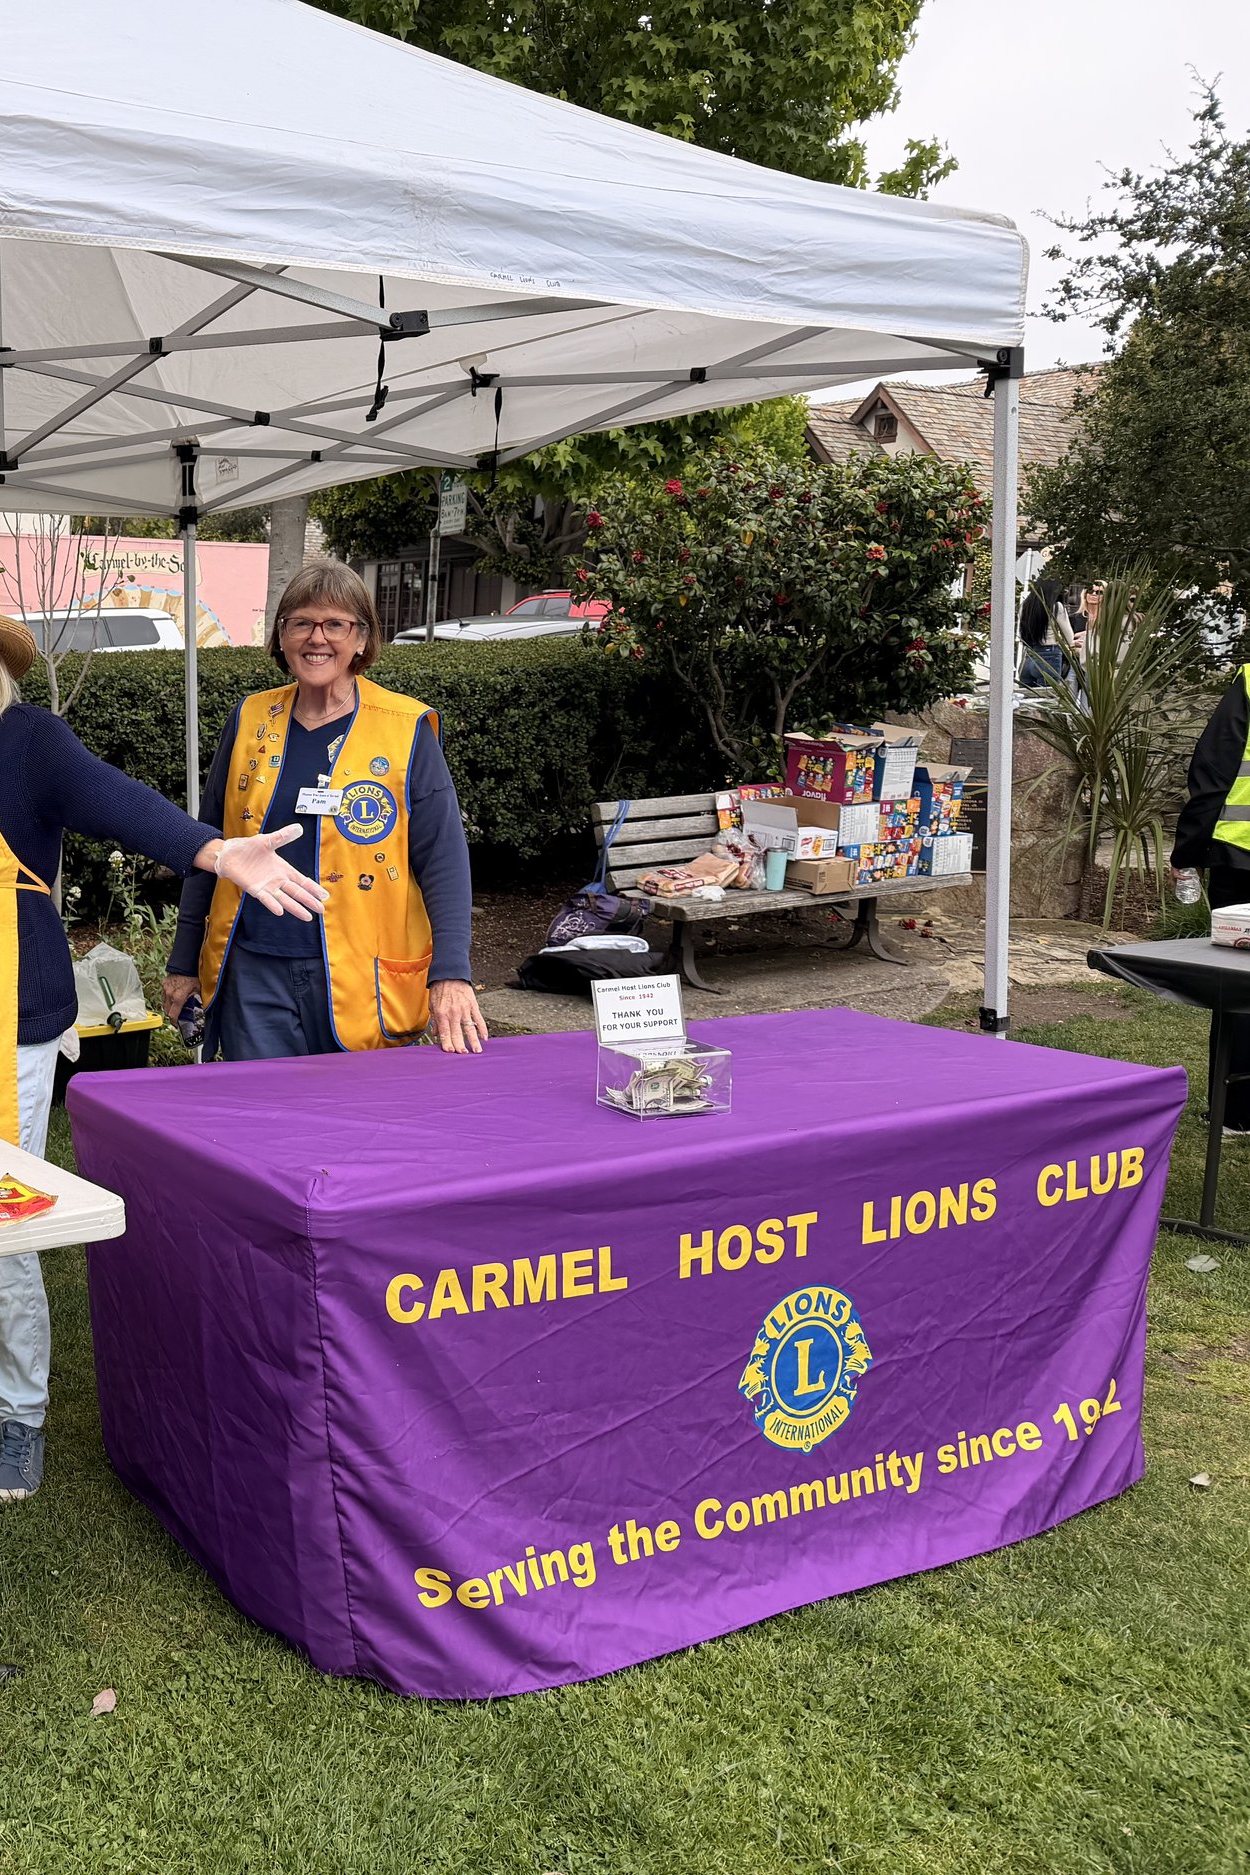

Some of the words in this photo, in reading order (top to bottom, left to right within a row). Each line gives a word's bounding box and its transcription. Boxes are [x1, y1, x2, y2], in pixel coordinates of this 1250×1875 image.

[442, 492, 465, 507] PARKING
[348, 786, 382, 798] LIONS
[359, 800, 375, 819] L
[597, 985, 620, 993] Carmel
[621, 984, 637, 992] Host
[612, 1010, 641, 1019] THANK
[646, 1008, 664, 1016] YOU
[602, 1023, 618, 1031] FOR
[619, 1021, 641, 1030] YOUR
[643, 1018, 678, 1028] SUPPORT
[385, 1245, 628, 1325] CARMEL
[678, 1211, 819, 1279] HOST
[861, 1176, 998, 1245] LIONS
[1036, 1145, 1146, 1208] CLUB
[766, 1289, 849, 1342] LIONS
[793, 1337, 826, 1397] L
[769, 1403, 846, 1443] INTERNATIONAL
[414, 1539, 597, 1611] Serving
[608, 1518, 680, 1566] the
[694, 1448, 924, 1541] Community
[937, 1421, 1044, 1475] since
